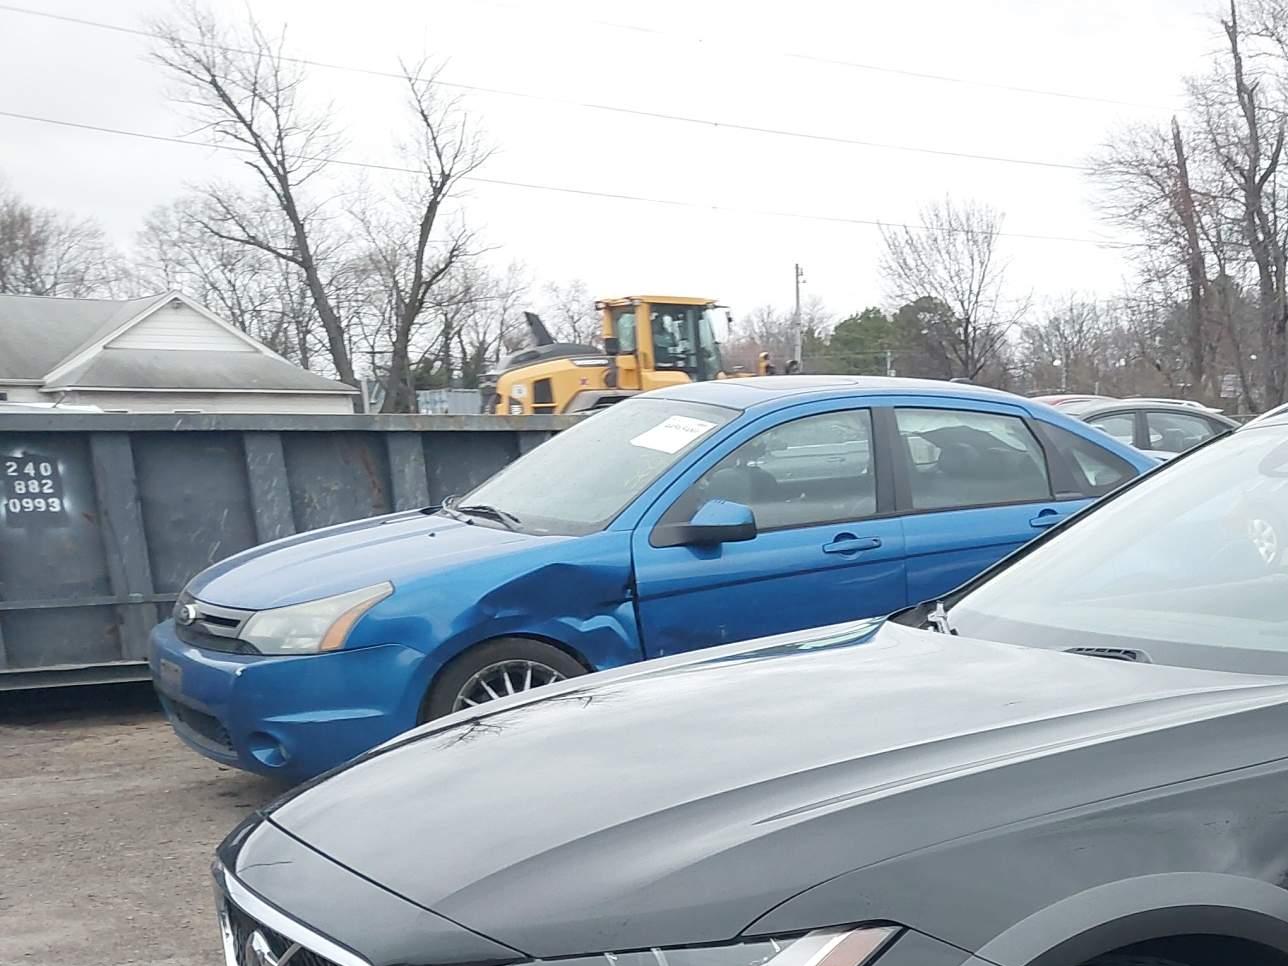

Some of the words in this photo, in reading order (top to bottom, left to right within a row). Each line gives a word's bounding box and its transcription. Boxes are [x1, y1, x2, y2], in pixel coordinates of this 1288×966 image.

[5, 461, 52, 477] 240
[14, 479, 54, 494] 882
[9, 497, 61, 513] 0993
